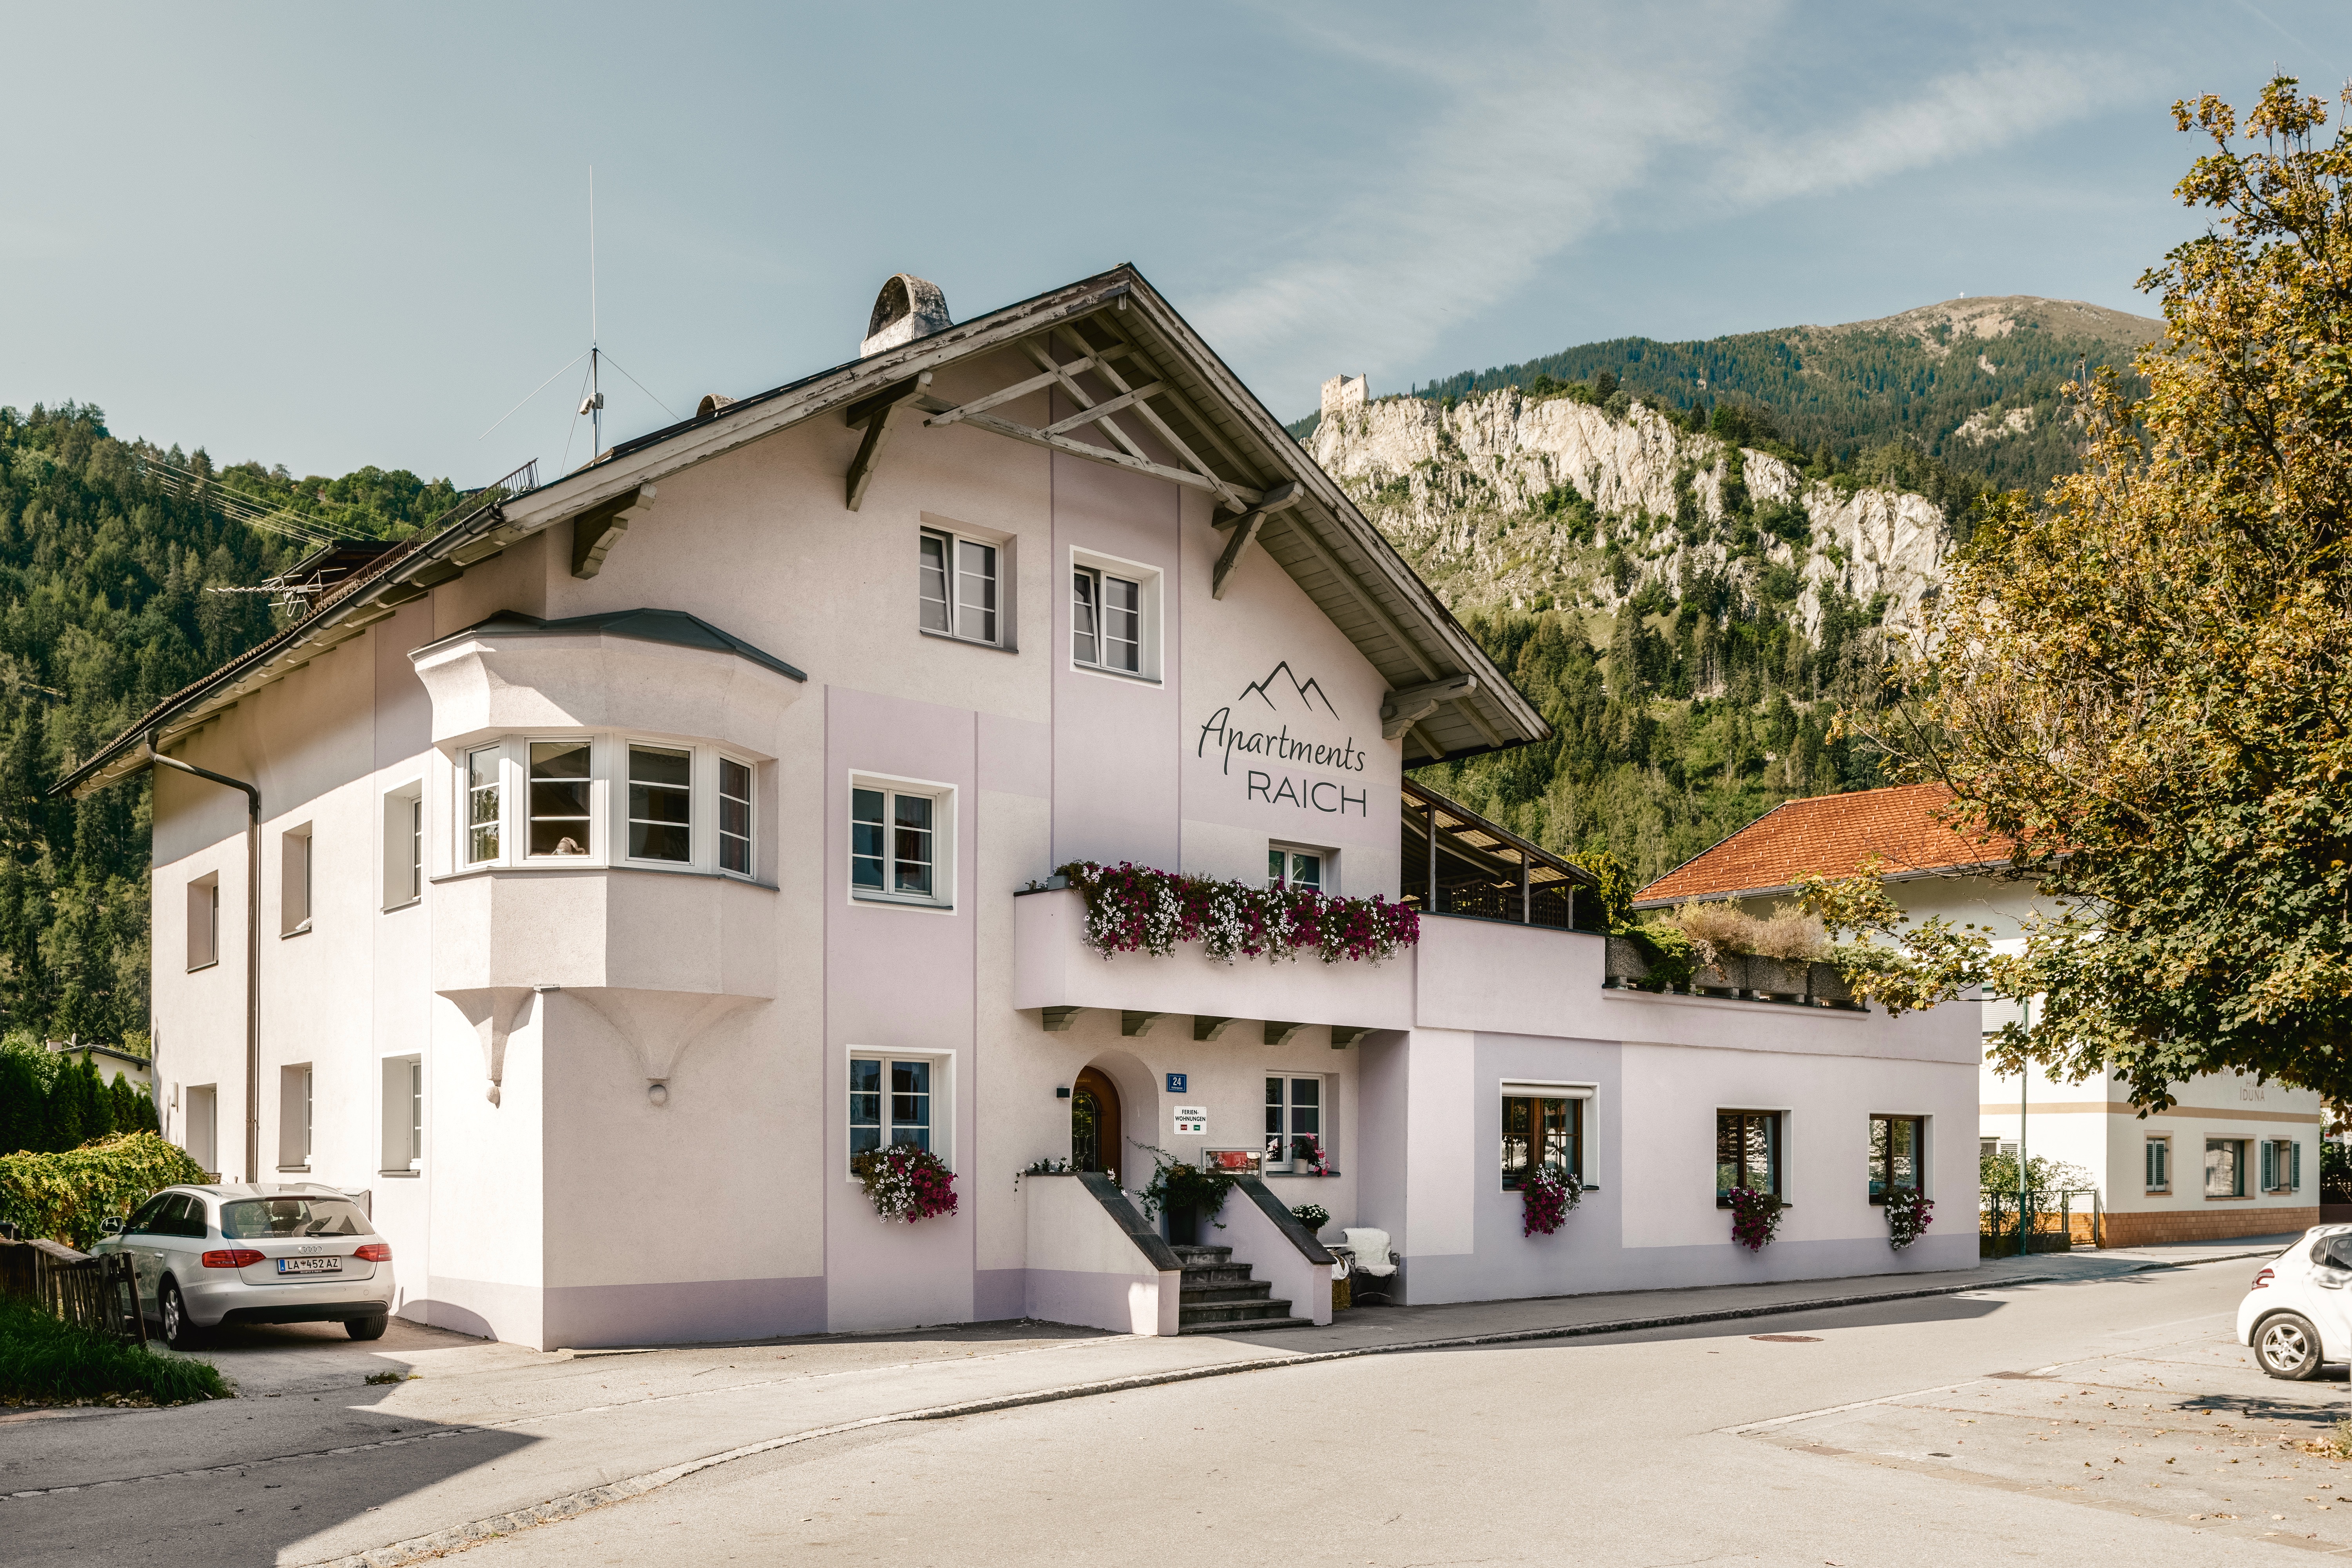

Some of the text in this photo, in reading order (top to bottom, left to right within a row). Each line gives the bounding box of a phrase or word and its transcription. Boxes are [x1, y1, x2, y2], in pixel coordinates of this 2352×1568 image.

[1198, 707, 1365, 775] Apartments
[1248, 770, 1366, 817] RAICH
[1173, 1077, 1181, 1086] 24
[2240, 1086, 2265, 1102] IDUNA
[288, 1259, 338, 1269] LA 452 AZ
